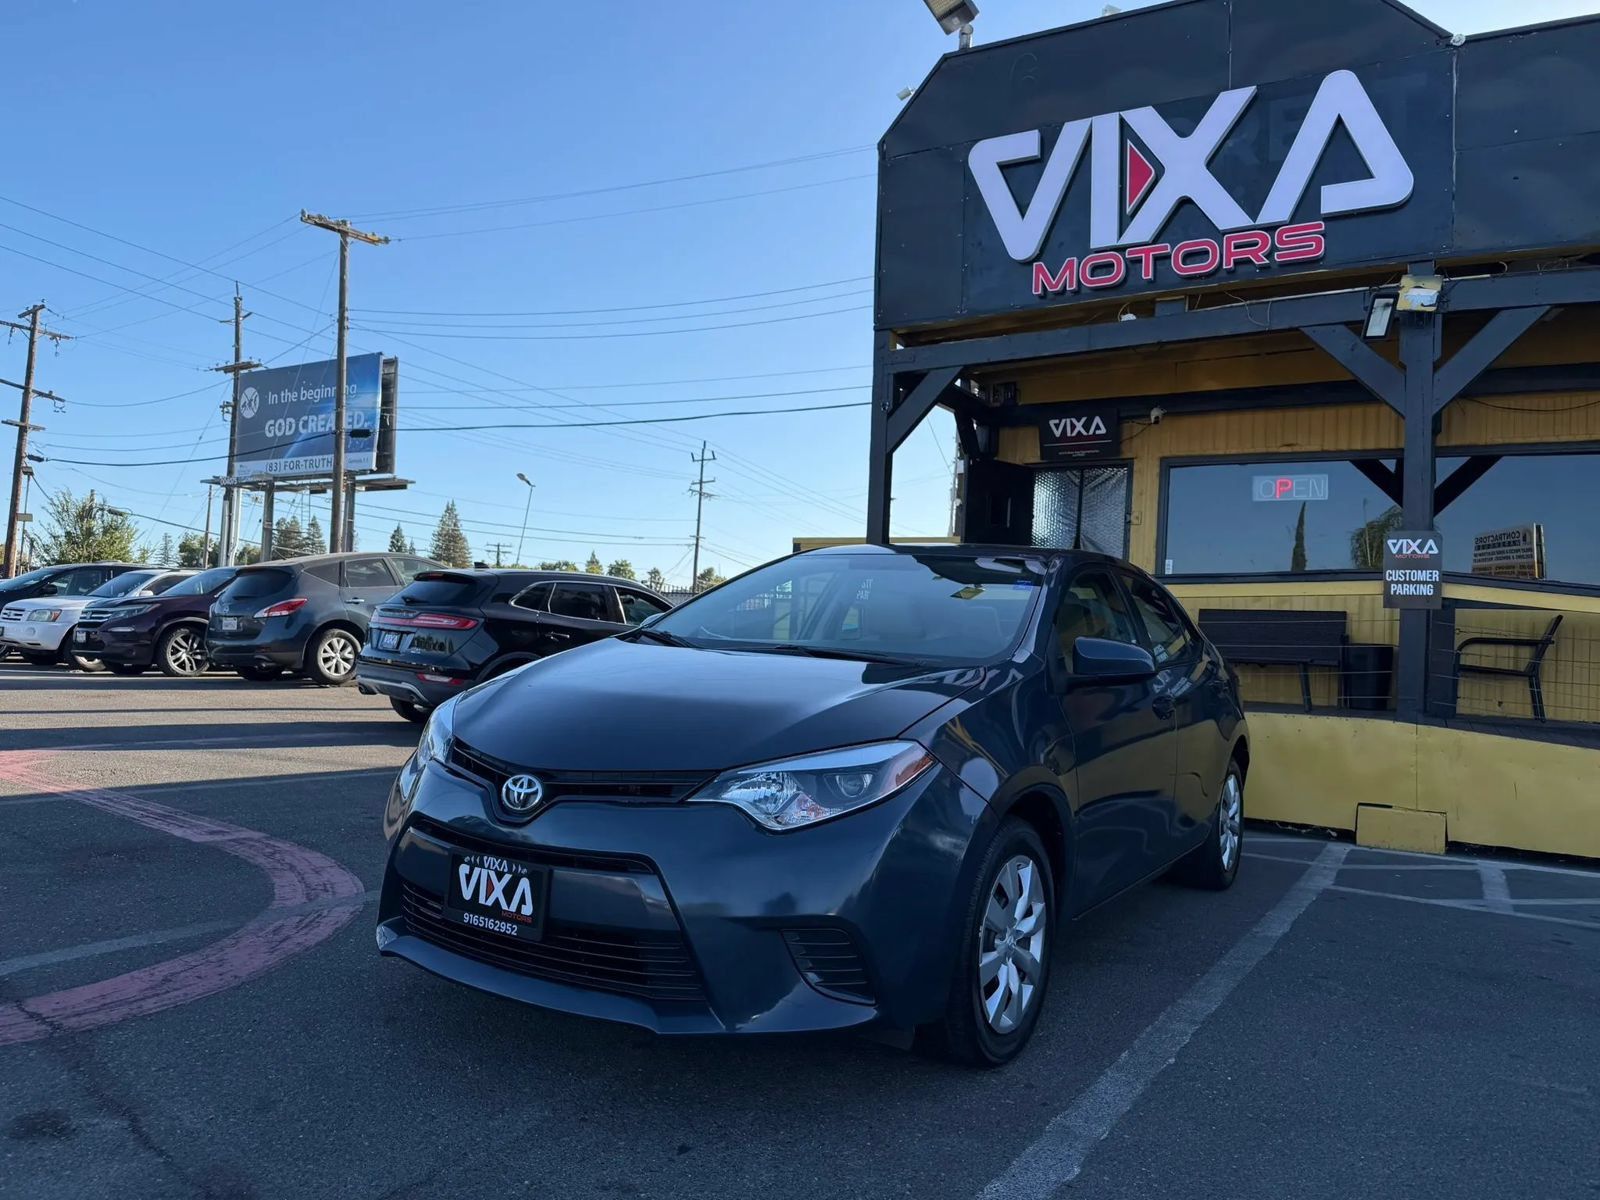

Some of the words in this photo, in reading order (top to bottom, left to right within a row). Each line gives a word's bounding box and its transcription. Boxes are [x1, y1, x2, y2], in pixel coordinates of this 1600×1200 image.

[968, 69, 1415, 262] VIXA
[1031, 221, 1326, 296] MOTORS
[268, 391, 279, 405] In
[281, 389, 298, 403] the
[300, 383, 357, 402] beginnng
[264, 417, 296, 438] GOD
[1048, 415, 1107, 438] VIXA
[265, 459, 282, 473] (83)
[283, 457, 333, 471] FOR-TRUTH
[1259, 478, 1324, 499] OPEN
[1387, 538, 1439, 555] VIXA
[1385, 569, 1440, 582] CUSTOMER
[1390, 583, 1434, 596] PARKING
[483, 855, 508, 873] VIXA
[458, 863, 534, 916] VIXA
[463, 912, 518, 936] 9165162952
[501, 910, 533, 924] MOTORS
